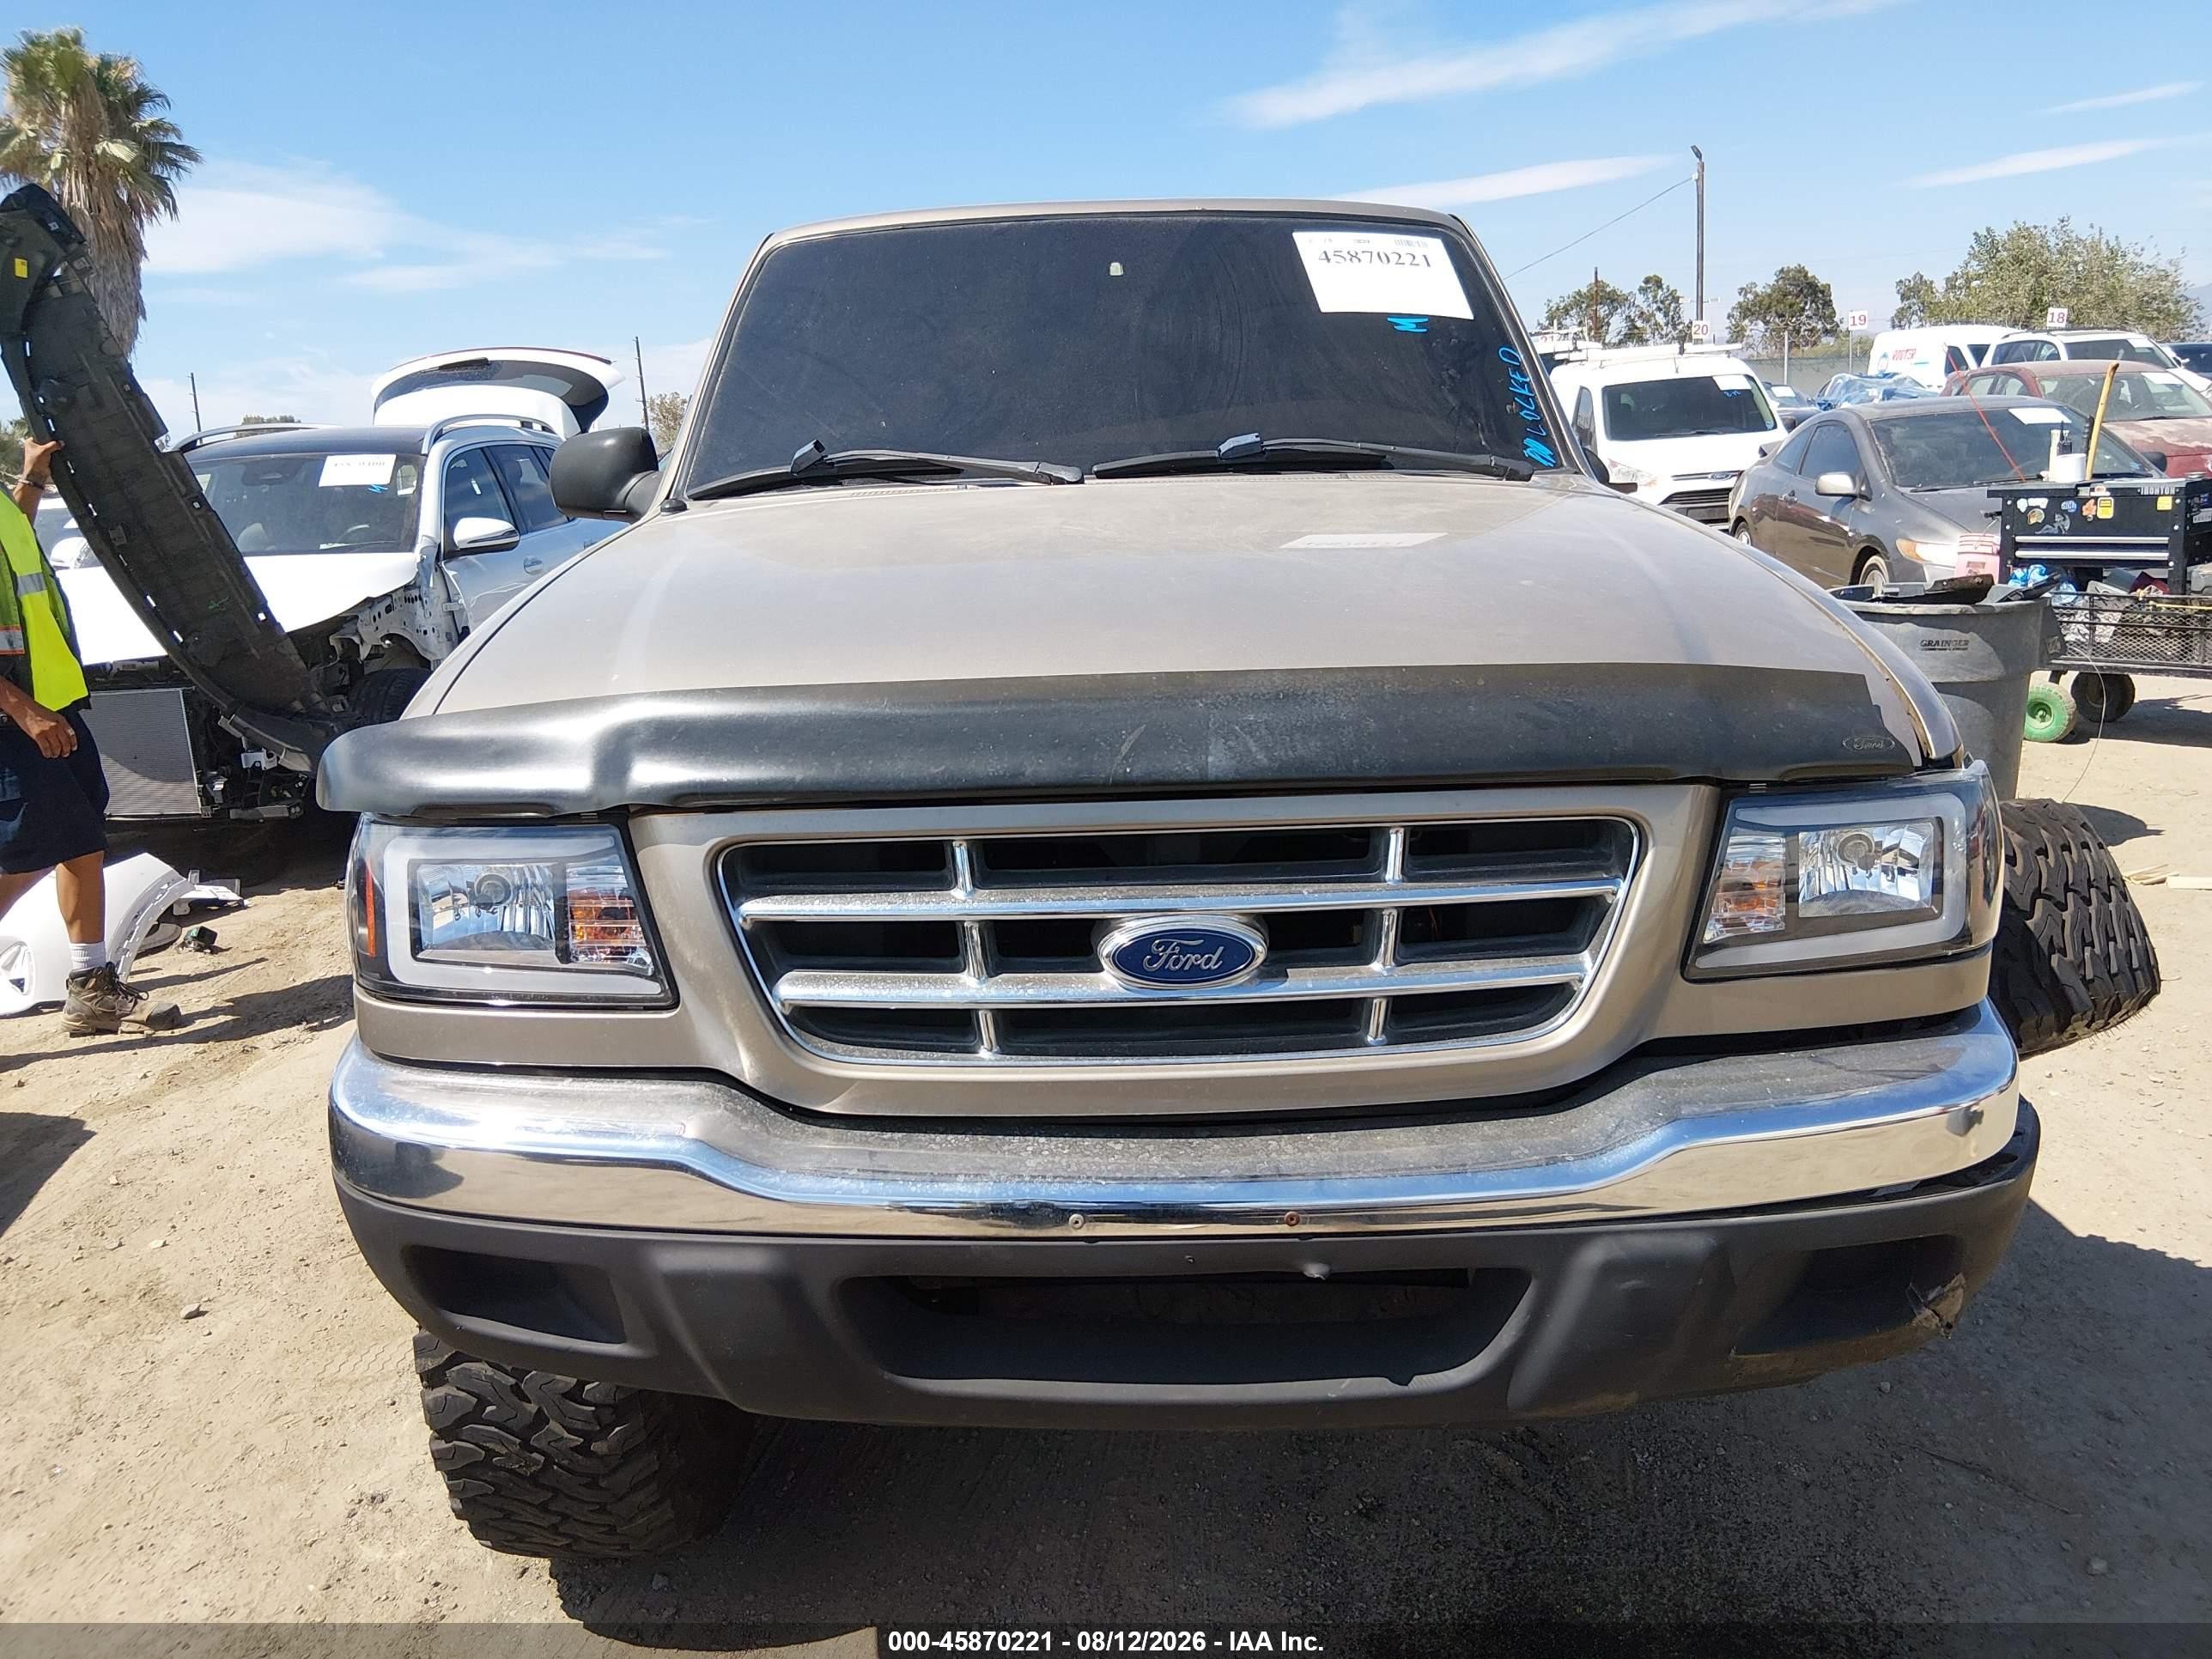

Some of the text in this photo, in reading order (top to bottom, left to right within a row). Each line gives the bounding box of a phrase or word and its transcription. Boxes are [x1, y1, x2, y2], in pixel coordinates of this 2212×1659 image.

[1318, 250, 1431, 268] 45870221
[1850, 314, 1867, 326] 19
[2048, 312, 2065, 324] 18
[1692, 324, 1709, 335] 20
[1143, 939, 1224, 972] Ford
